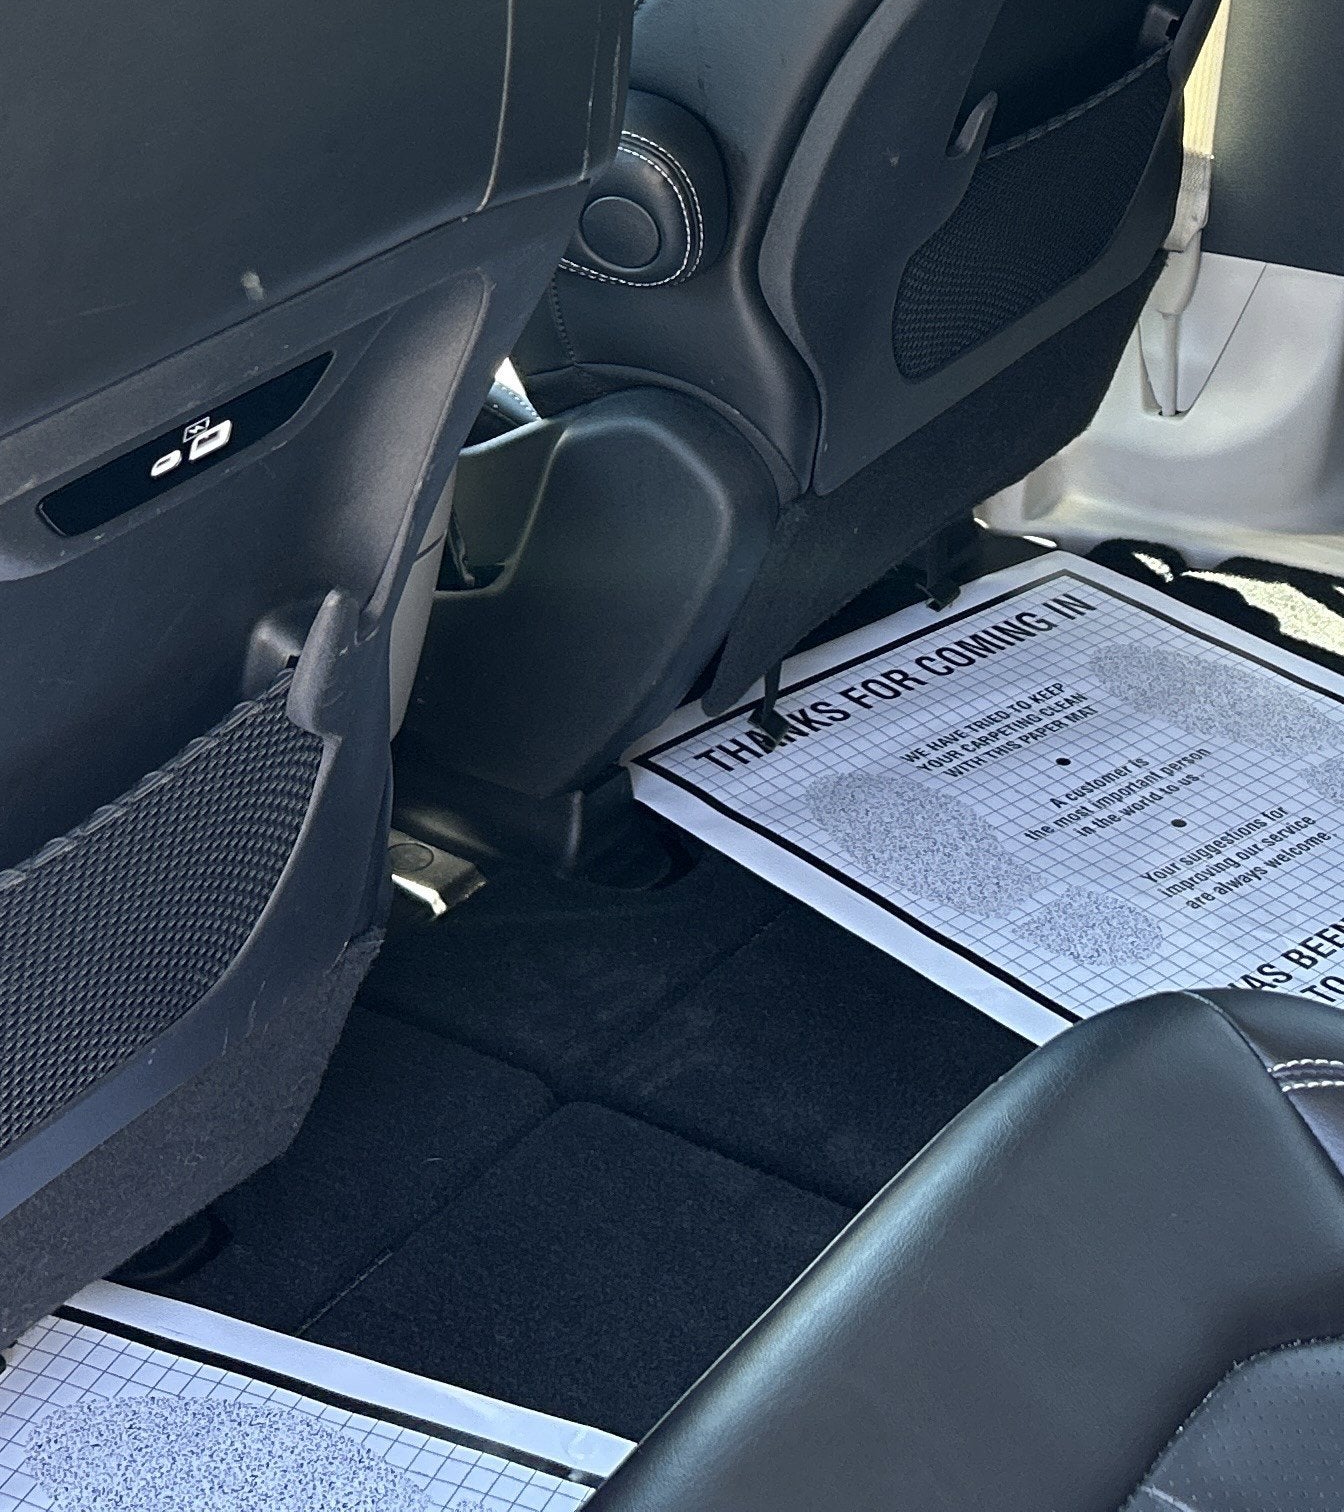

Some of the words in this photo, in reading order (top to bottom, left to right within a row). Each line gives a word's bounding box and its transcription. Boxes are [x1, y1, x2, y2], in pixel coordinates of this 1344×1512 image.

[839, 669, 928, 709] FOR
[915, 611, 1058, 676] COMING
[1042, 593, 1097, 620] IN
[900, 747, 929, 765] WE
[926, 730, 968, 751] HAVE
[965, 710, 1010, 734] TRIED
[1006, 699, 1032, 714] TO
[1028, 682, 1066, 704] KEEP
[916, 750, 964, 773] YOUR
[961, 713, 1043, 754] CARPETING
[1039, 692, 1089, 717] CLEAN
[942, 754, 987, 778] WITH
[984, 739, 1022, 759] THIS
[1017, 720, 1069, 745] PAPER
[1063, 704, 1099, 723] MAT
[1024, 824, 1056, 841] the
[1053, 805, 1096, 829] most
[1091, 770, 1163, 810] important
[1159, 747, 1212, 777] person
[1049, 797, 1068, 809] A
[1065, 764, 1133, 801] customer
[1128, 756, 1150, 769] is
[1073, 825, 1097, 837] in
[1091, 812, 1122, 829] the
[1118, 791, 1164, 817] world
[1158, 784, 1180, 795] to
[1140, 862, 1182, 884] Your
[1179, 818, 1268, 866] suggestions
[1262, 805, 1289, 826] for
[1156, 857, 1242, 899] improving
[1235, 843, 1265, 861] our
[1261, 815, 1317, 847] service
[1185, 892, 1216, 910] are
[1213, 865, 1269, 896] always
[1264, 830, 1338, 870] welcome.
[1228, 963, 1293, 989] AS
